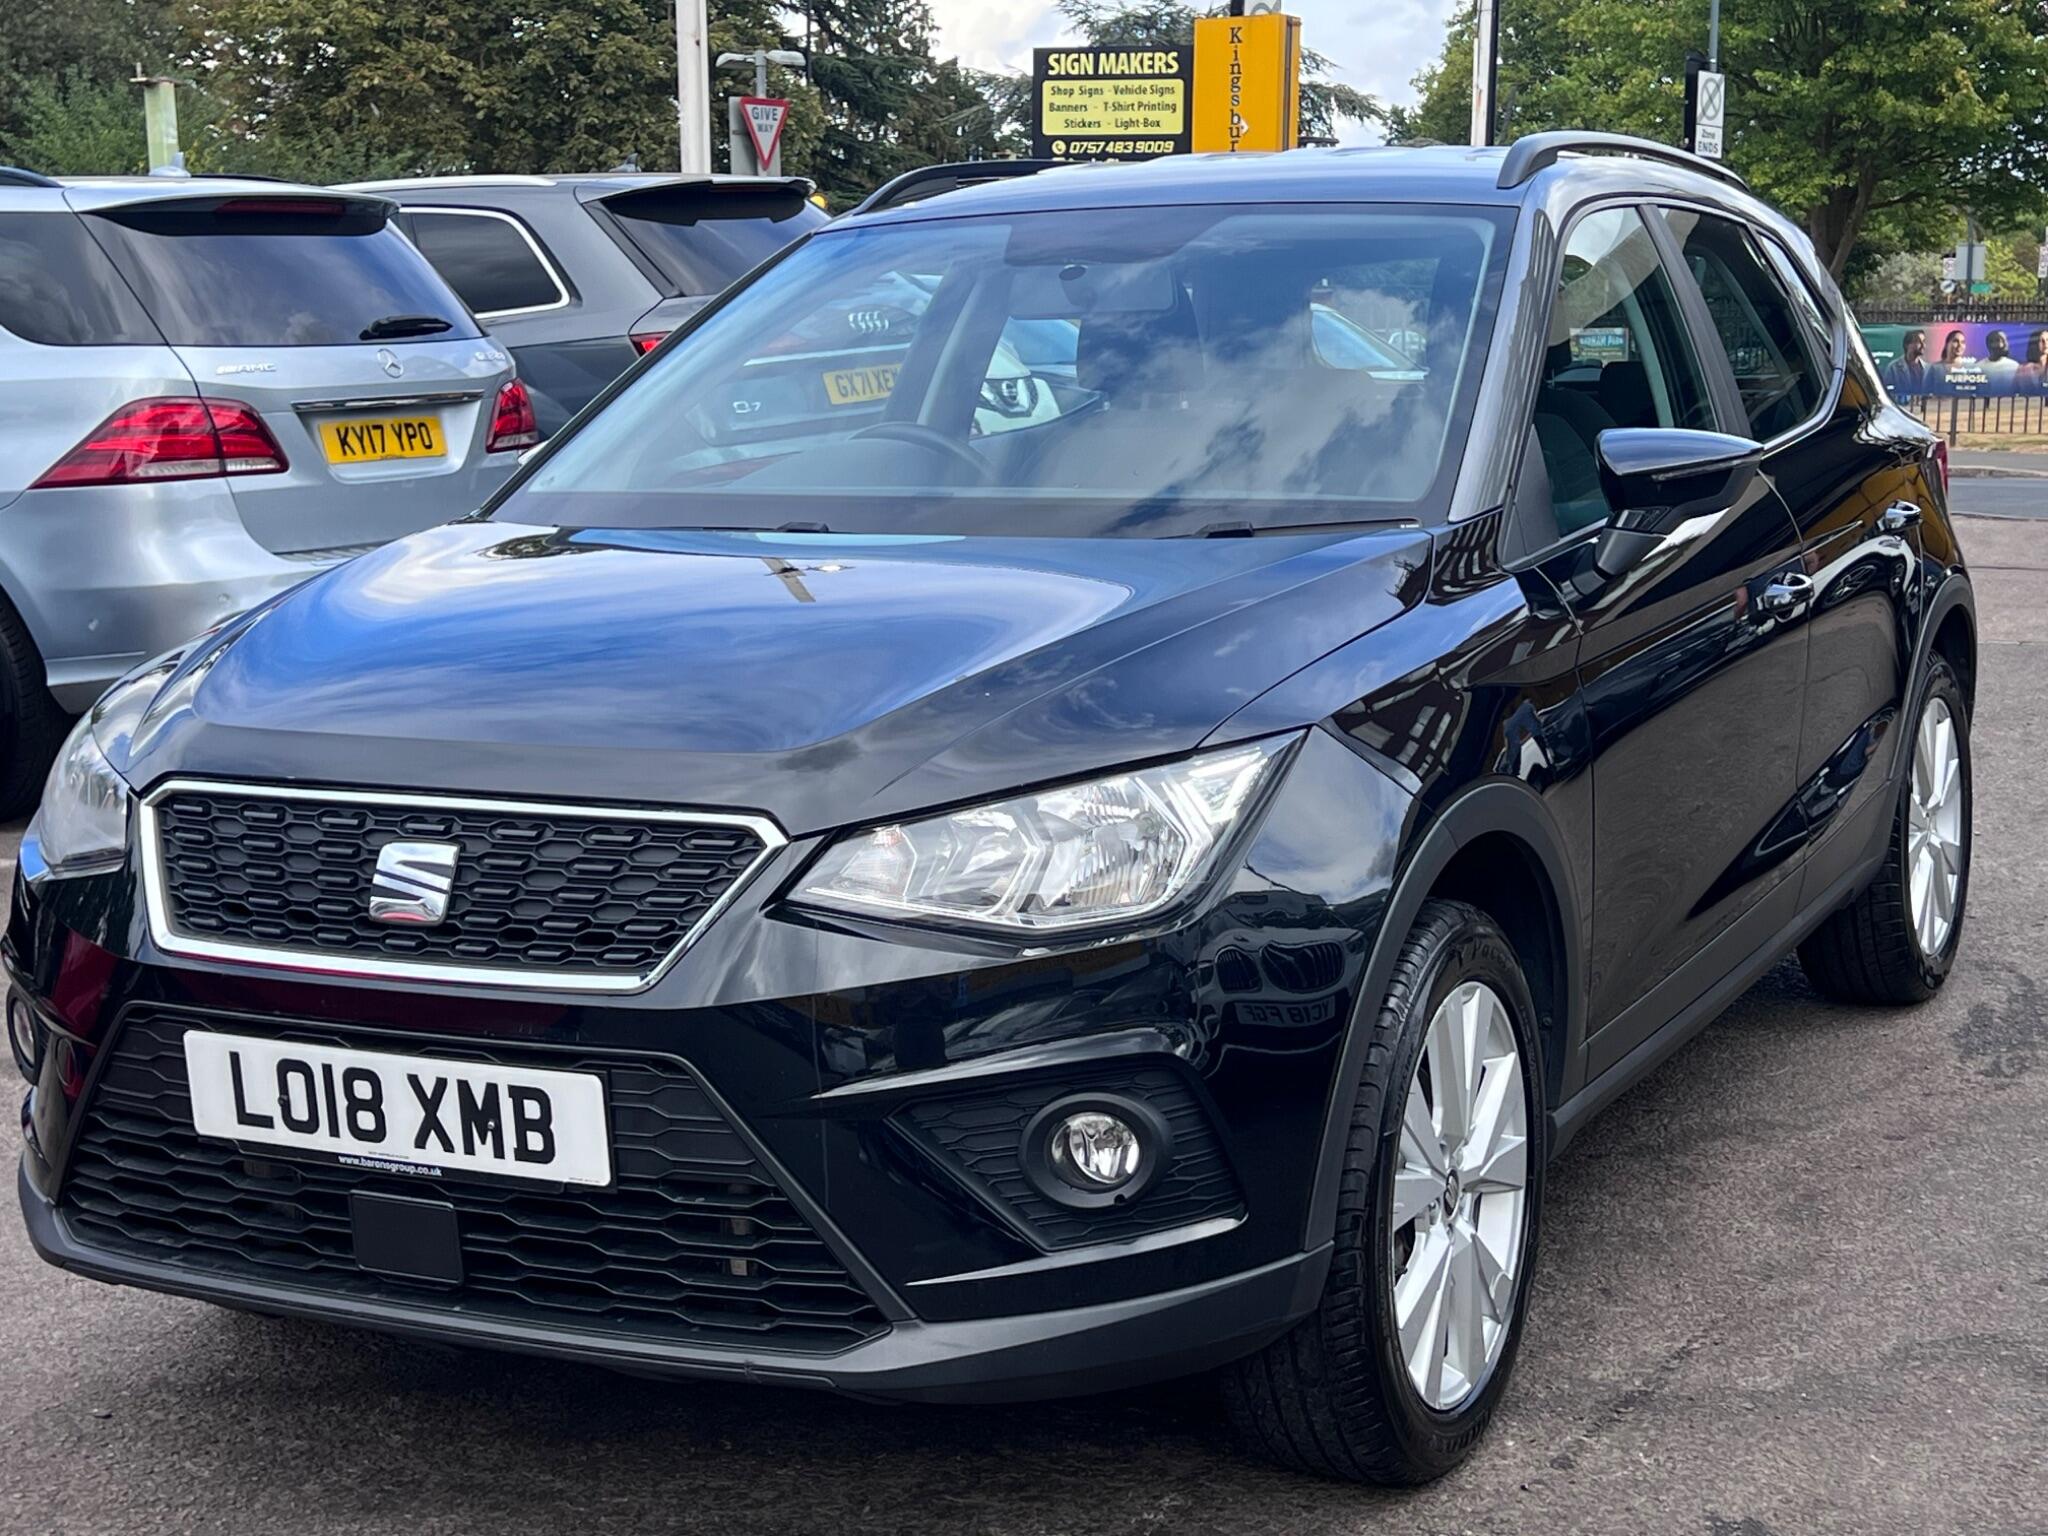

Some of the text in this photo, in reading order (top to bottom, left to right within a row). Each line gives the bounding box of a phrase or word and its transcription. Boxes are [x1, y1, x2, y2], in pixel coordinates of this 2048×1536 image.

[1048, 51, 1179, 75] SIGN MAKERS
[1050, 84, 1175, 98] Shop Signs Vehicle Signs
[751, 106, 778, 121] GIVE
[1049, 101, 1177, 113] Banners T-Shirt Printing
[757, 123, 774, 133] WAY
[1064, 117, 1161, 130] Stickers Light-Box
[1697, 141, 1719, 154] ENDS
[336, 424, 386, 457] KY17
[229, 1051, 556, 1165] LO18 XMB
[338, 1155, 442, 1177] www.baronsgroup.co.uk
